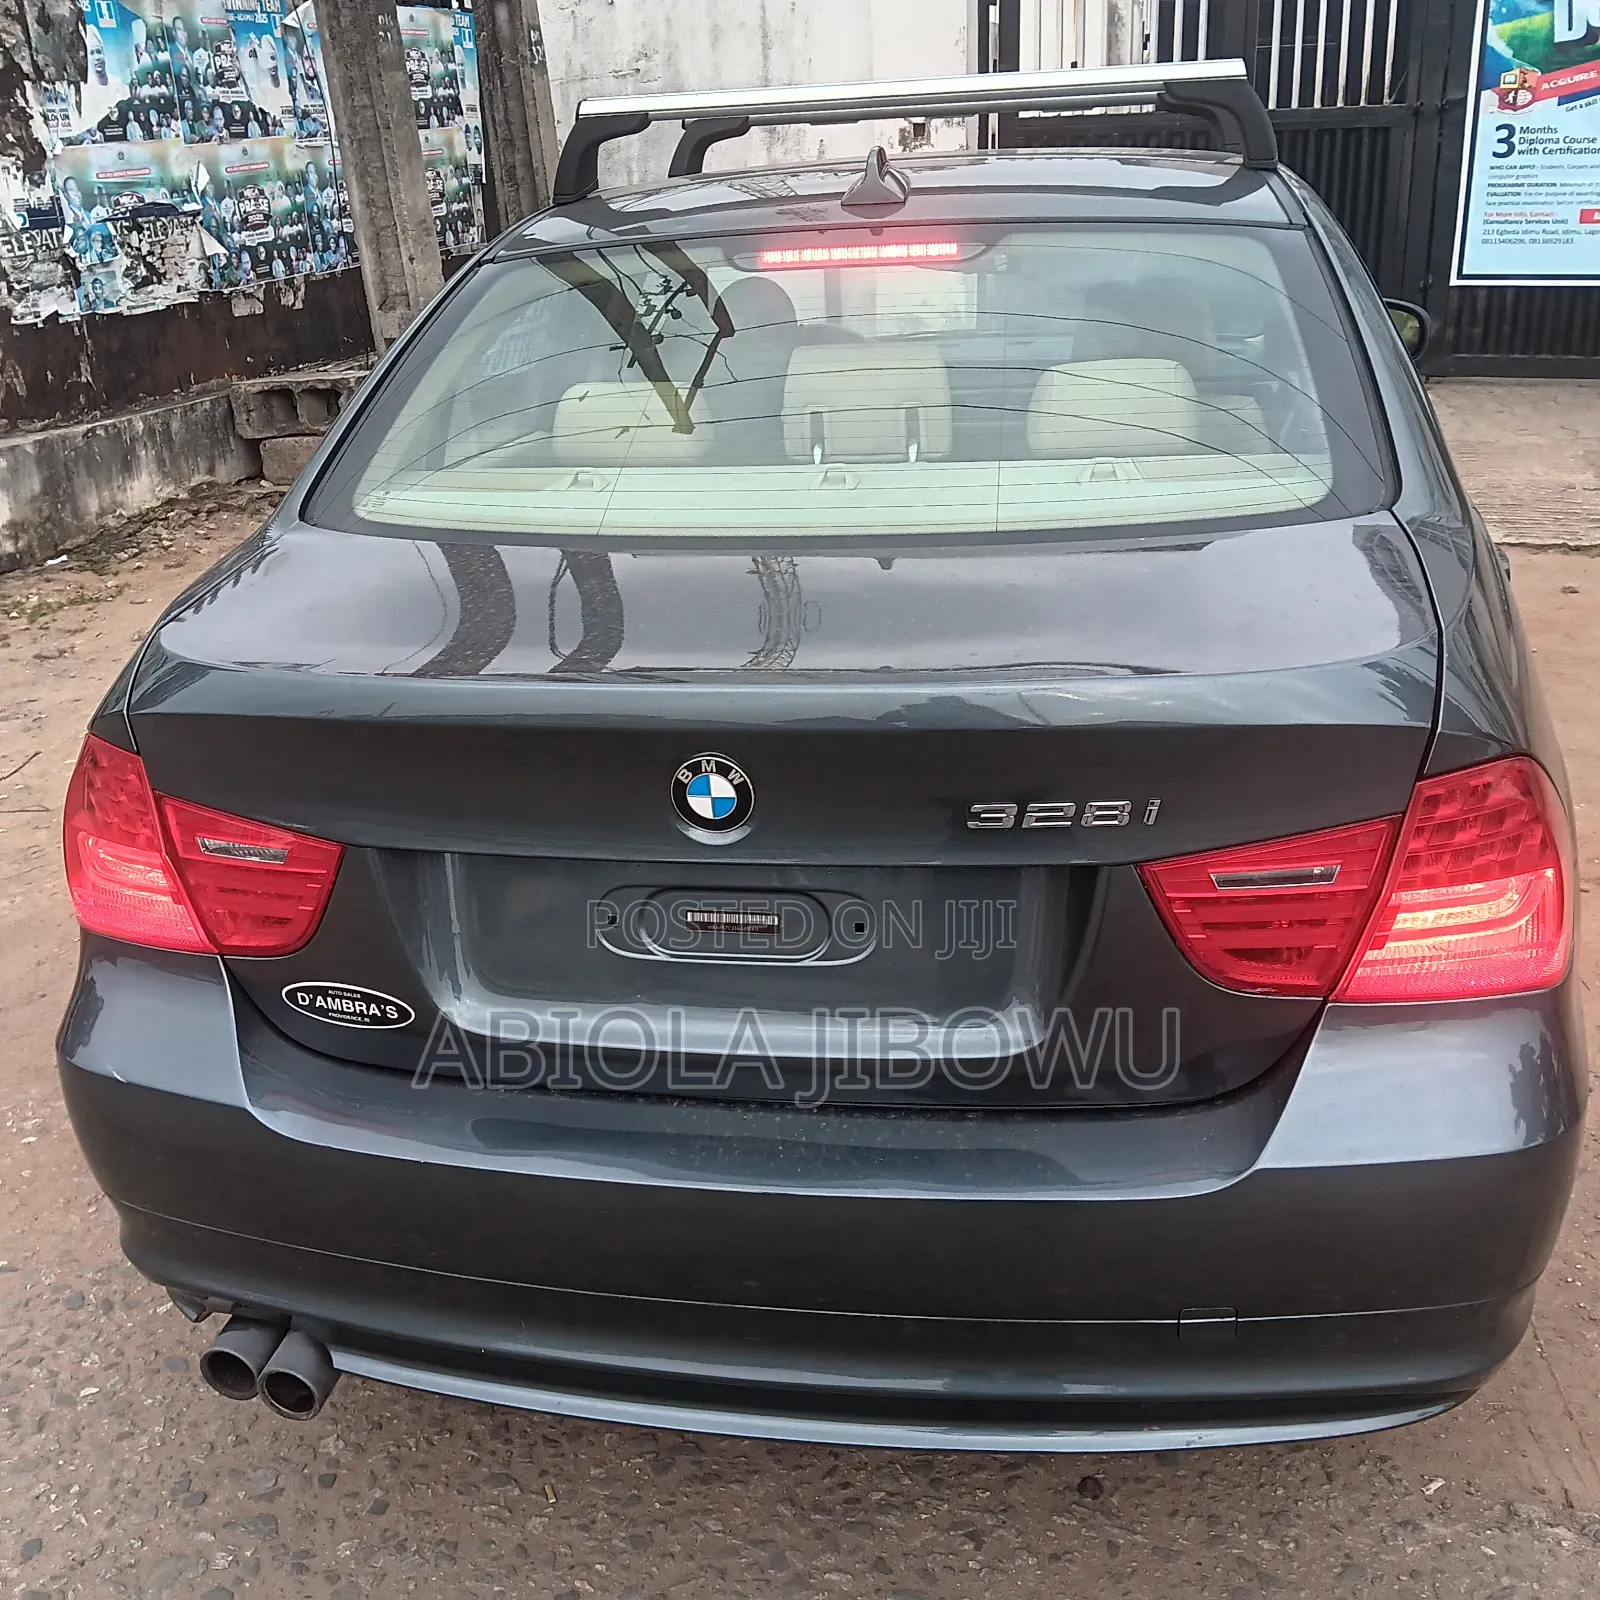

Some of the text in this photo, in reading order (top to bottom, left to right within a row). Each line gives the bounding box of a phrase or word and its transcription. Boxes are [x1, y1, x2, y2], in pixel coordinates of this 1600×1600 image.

[1541, 70, 1598, 90] ACQUIRE
[1519, 125, 1558, 134] Months
[1492, 123, 1516, 158] 3
[1517, 146, 1540, 155] with
[1518, 135, 1598, 146] Diploma Course
[677, 759, 745, 786] BMW
[297, 992, 399, 1019] D'AMBRA'S
